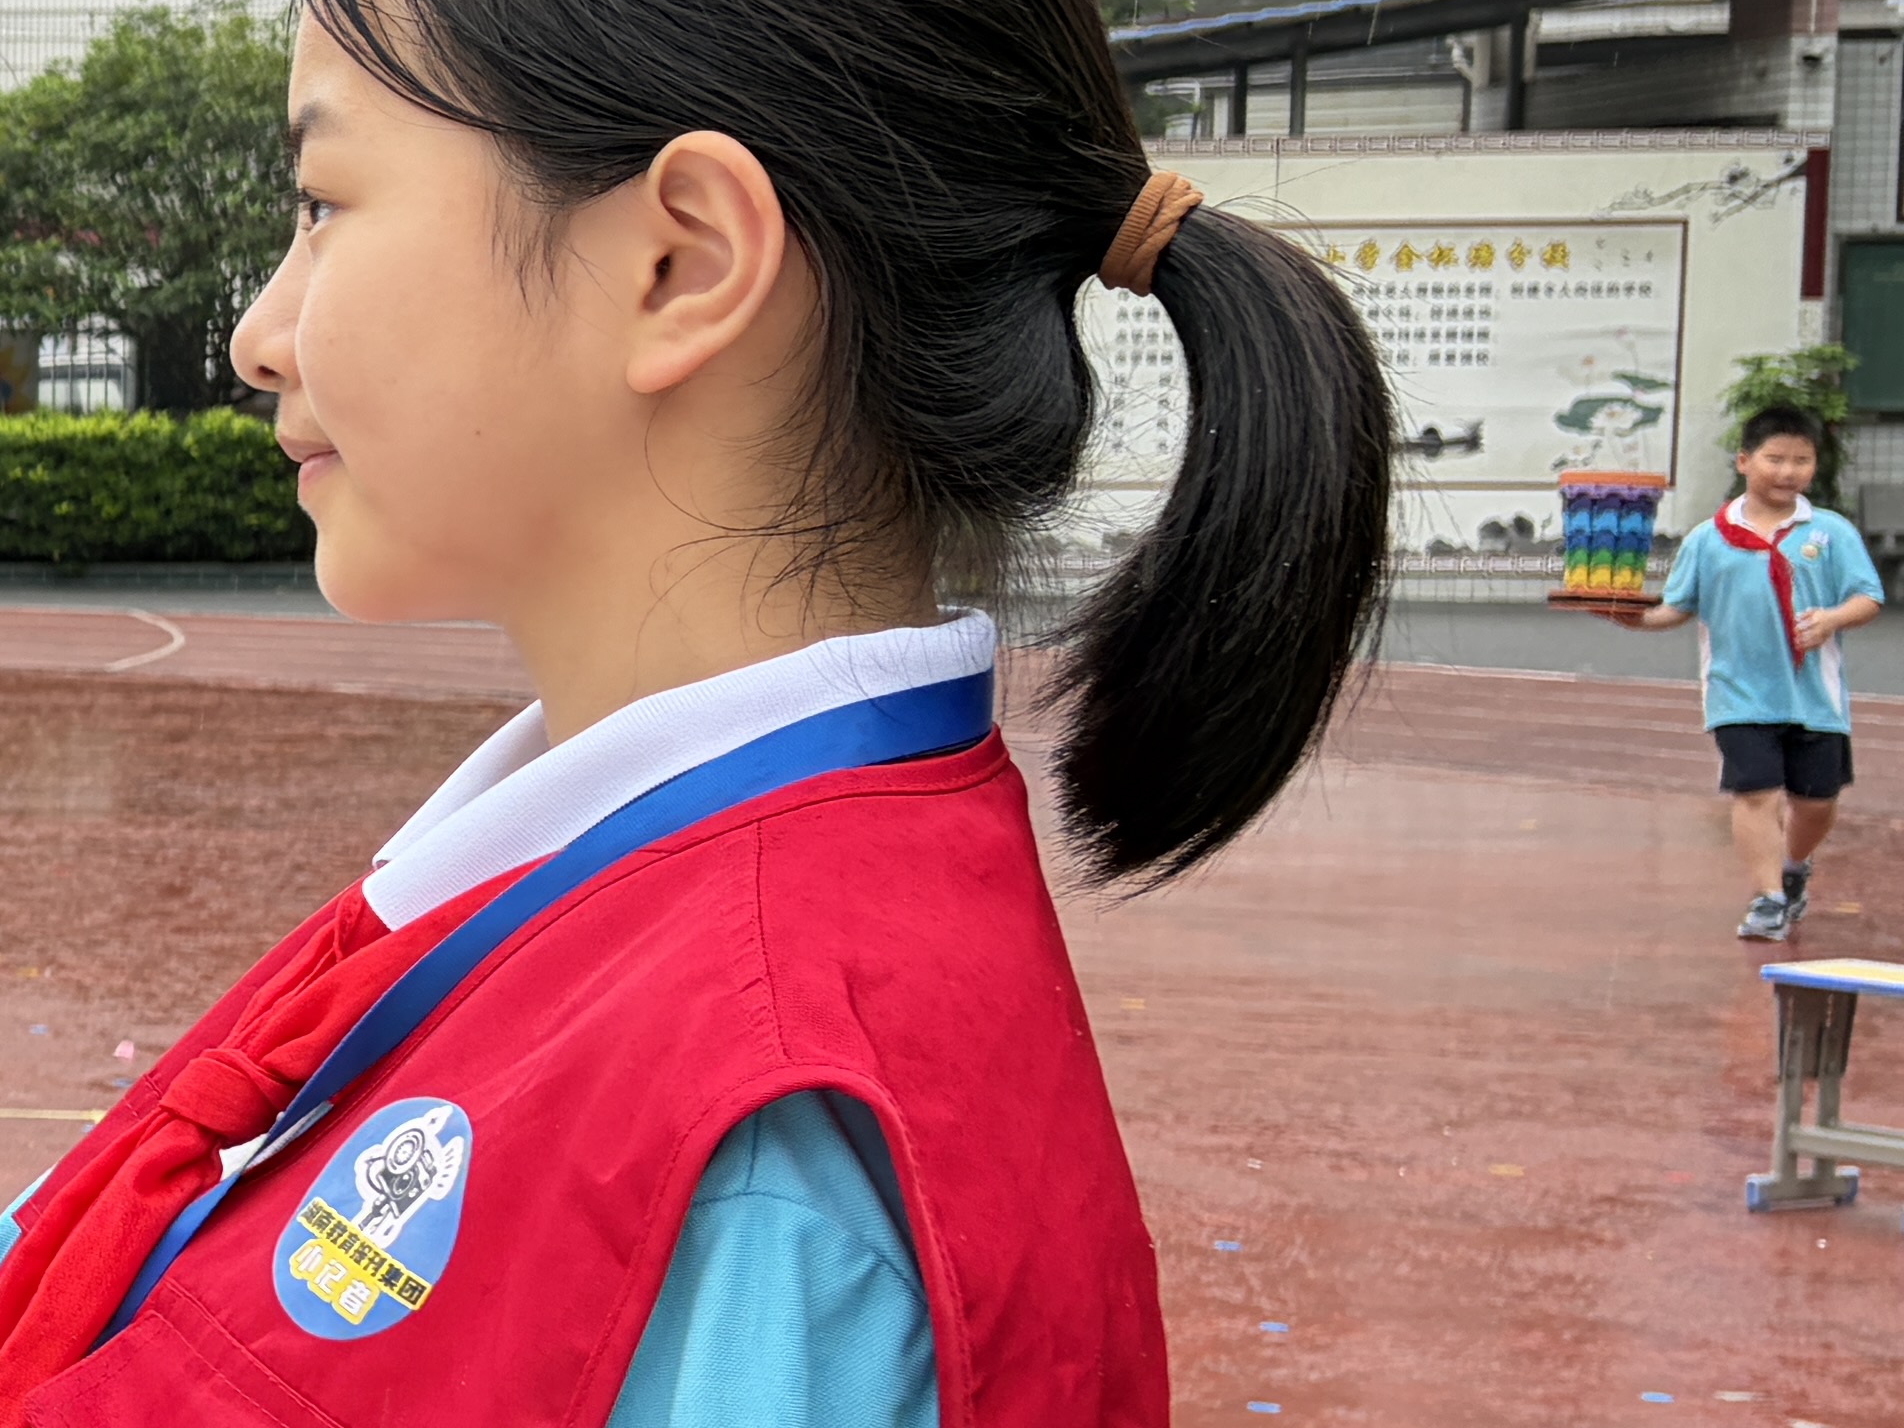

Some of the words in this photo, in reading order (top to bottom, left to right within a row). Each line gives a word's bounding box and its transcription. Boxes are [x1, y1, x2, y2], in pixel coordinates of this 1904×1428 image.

[295, 1245, 371, 1315] 小记者
[300, 1200, 427, 1305] 湖南教育报刊集团
